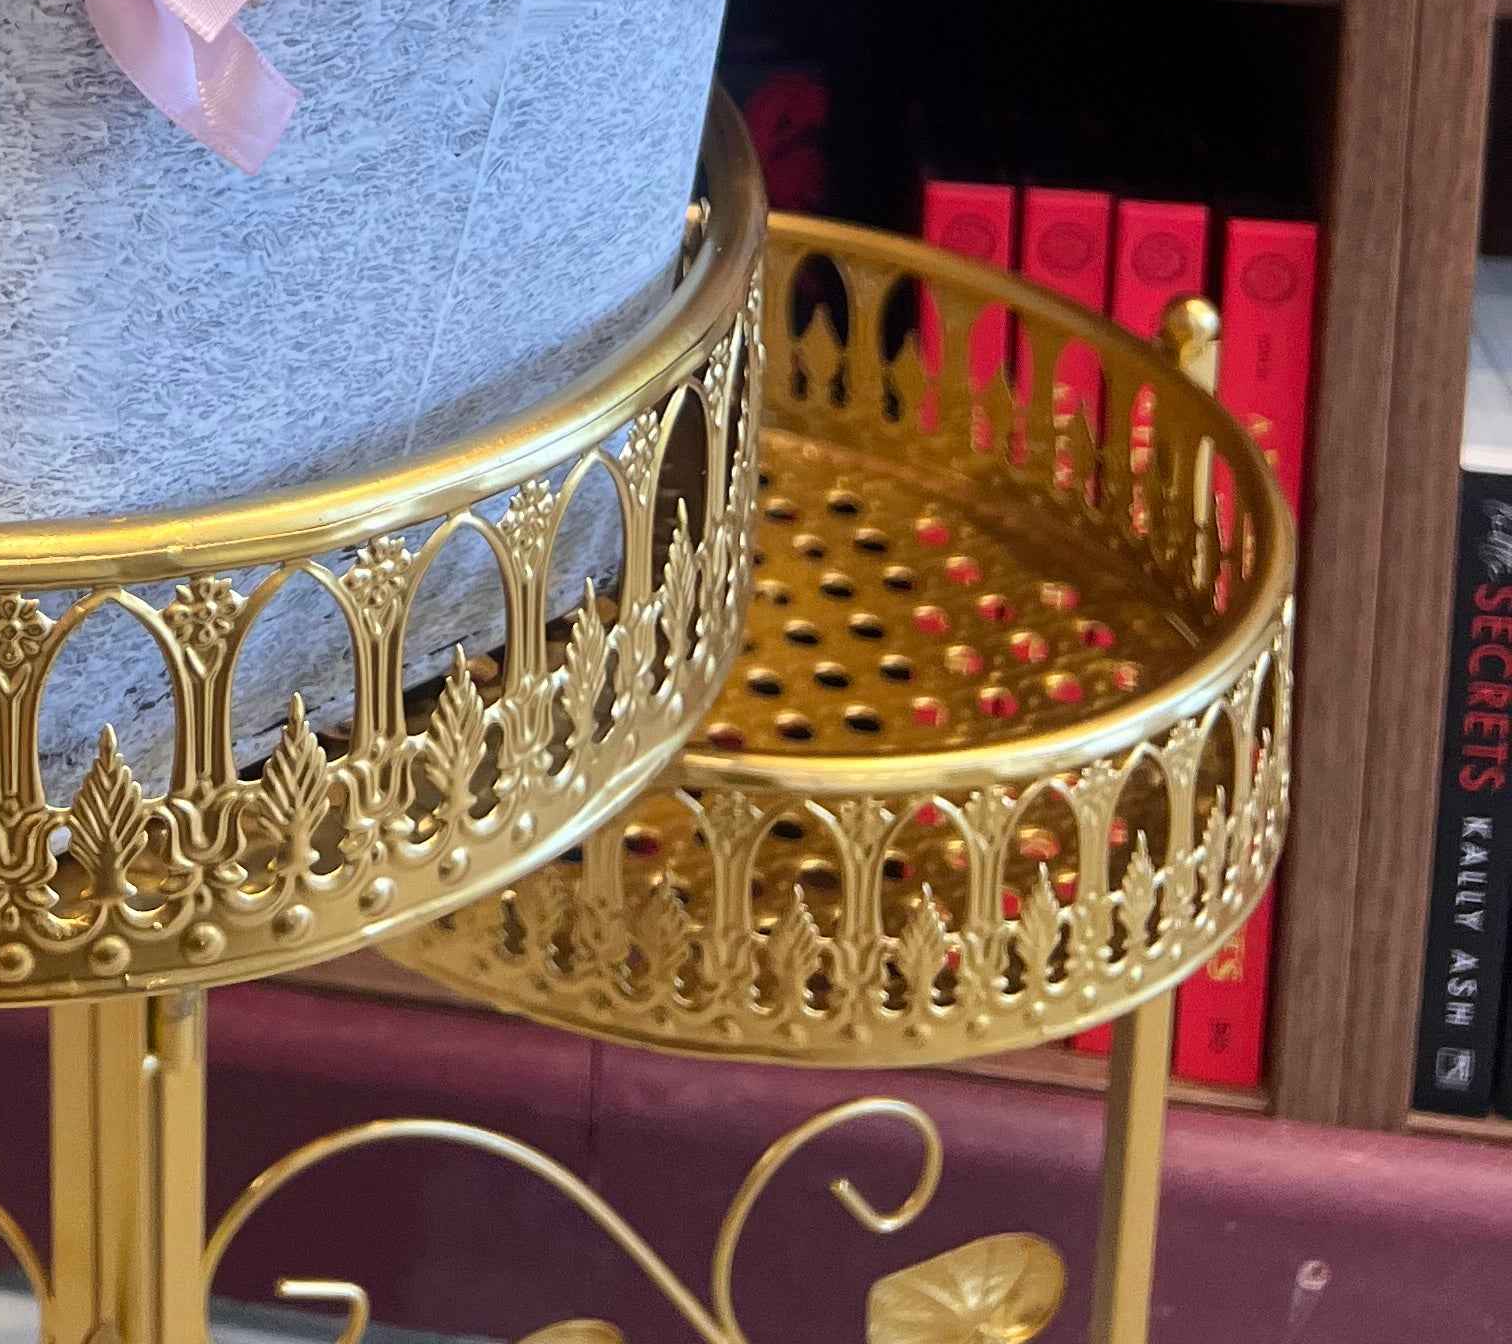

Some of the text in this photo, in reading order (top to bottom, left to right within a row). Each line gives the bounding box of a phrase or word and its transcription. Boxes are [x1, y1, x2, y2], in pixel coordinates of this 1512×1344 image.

[1458, 582, 1512, 793] SECRETS
[1454, 815, 1494, 932] KALLY
[1444, 947, 1481, 1028] ASH
